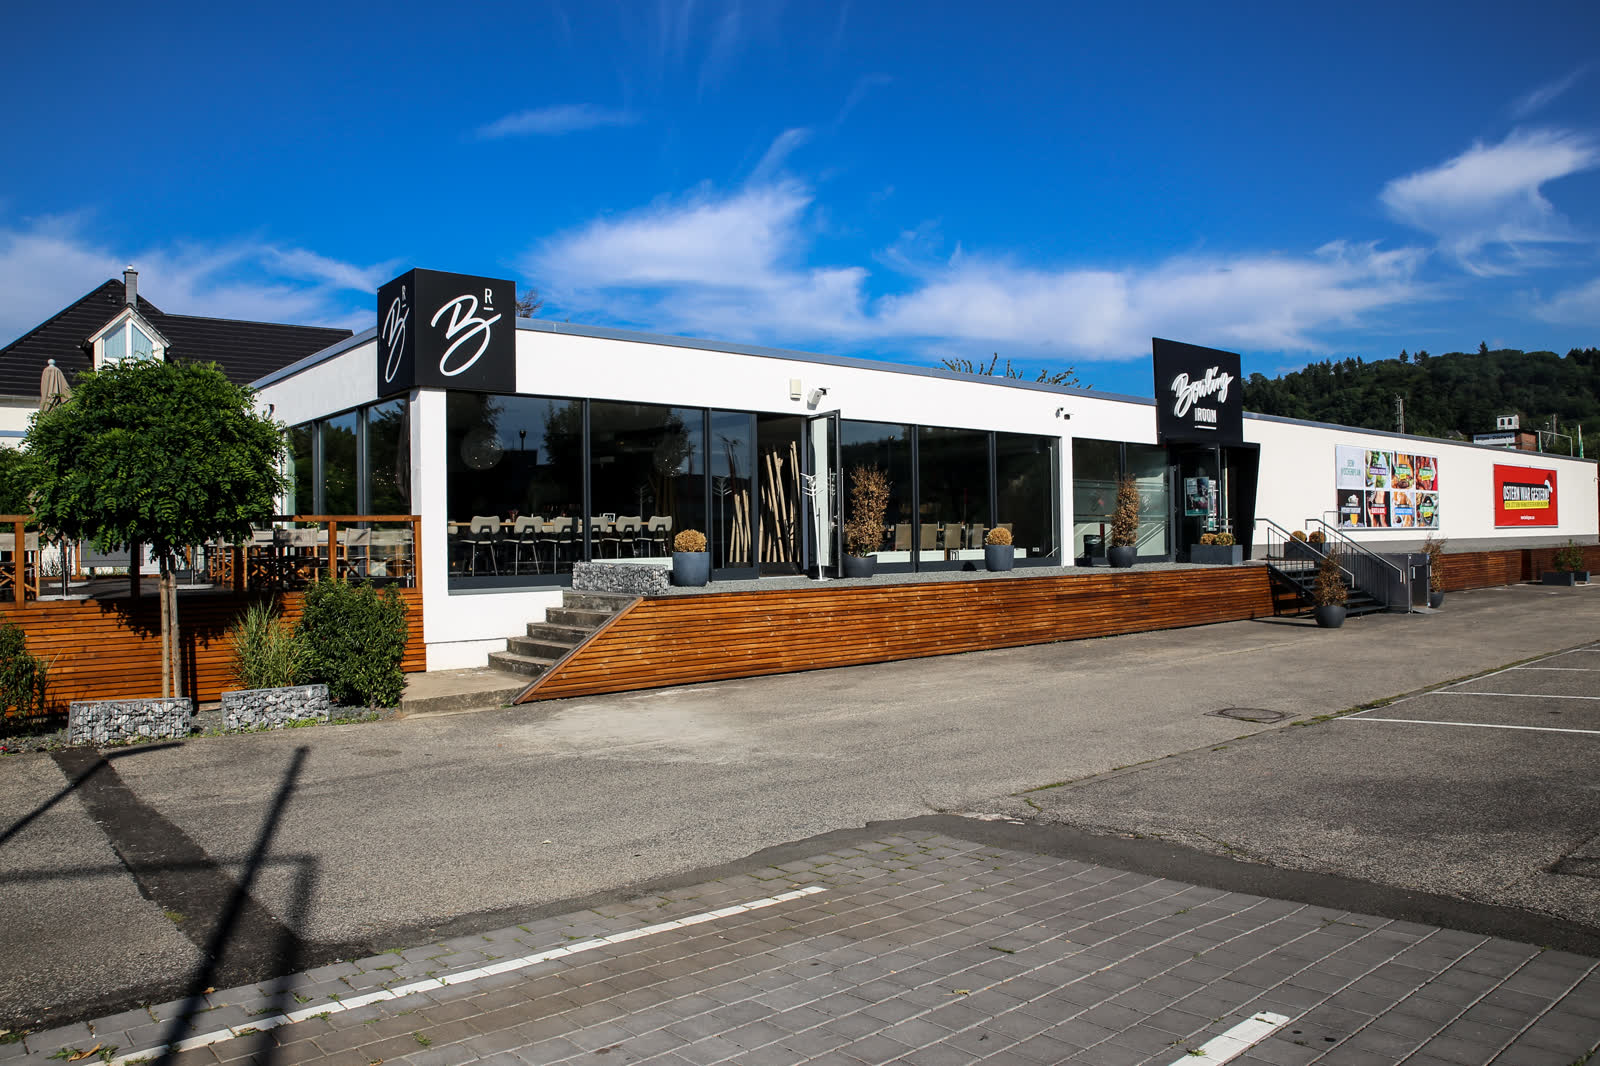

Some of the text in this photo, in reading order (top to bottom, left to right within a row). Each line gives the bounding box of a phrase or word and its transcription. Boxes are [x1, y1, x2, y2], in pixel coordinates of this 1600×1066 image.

[484, 288, 492, 304] R
[430, 294, 502, 377] B
[1171, 365, 1234, 418] Bowling
[1194, 407, 1217, 423] ROOM
